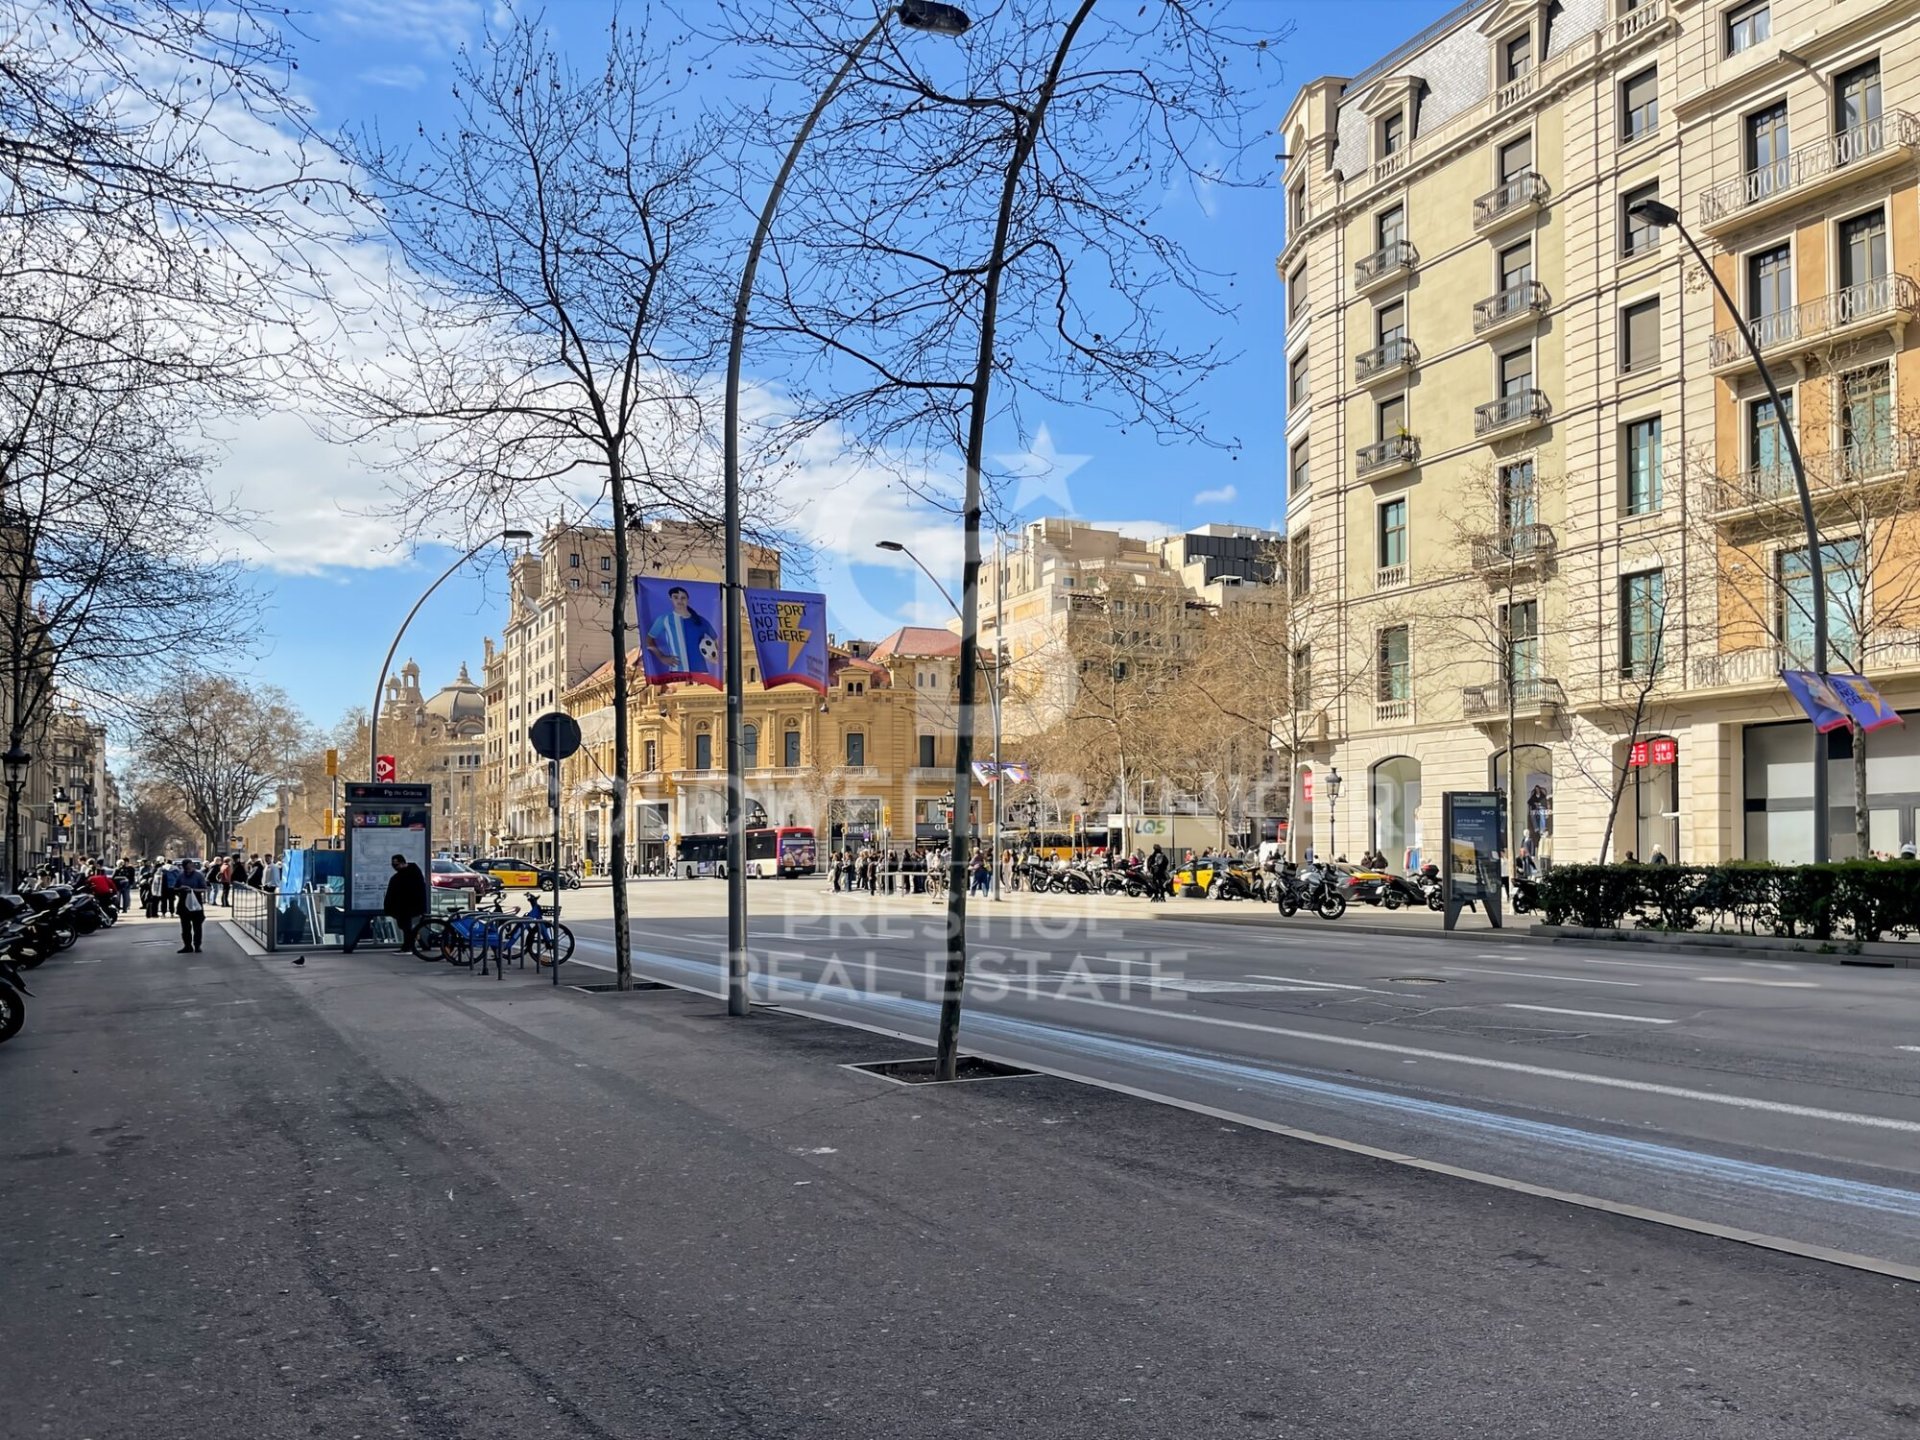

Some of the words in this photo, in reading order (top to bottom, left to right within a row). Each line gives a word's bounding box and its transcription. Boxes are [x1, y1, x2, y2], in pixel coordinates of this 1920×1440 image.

[752, 602, 807, 616] L'ESPORT
[755, 616, 773, 629] NO
[378, 763, 387, 772] M
[1135, 819, 1166, 834] LQS
